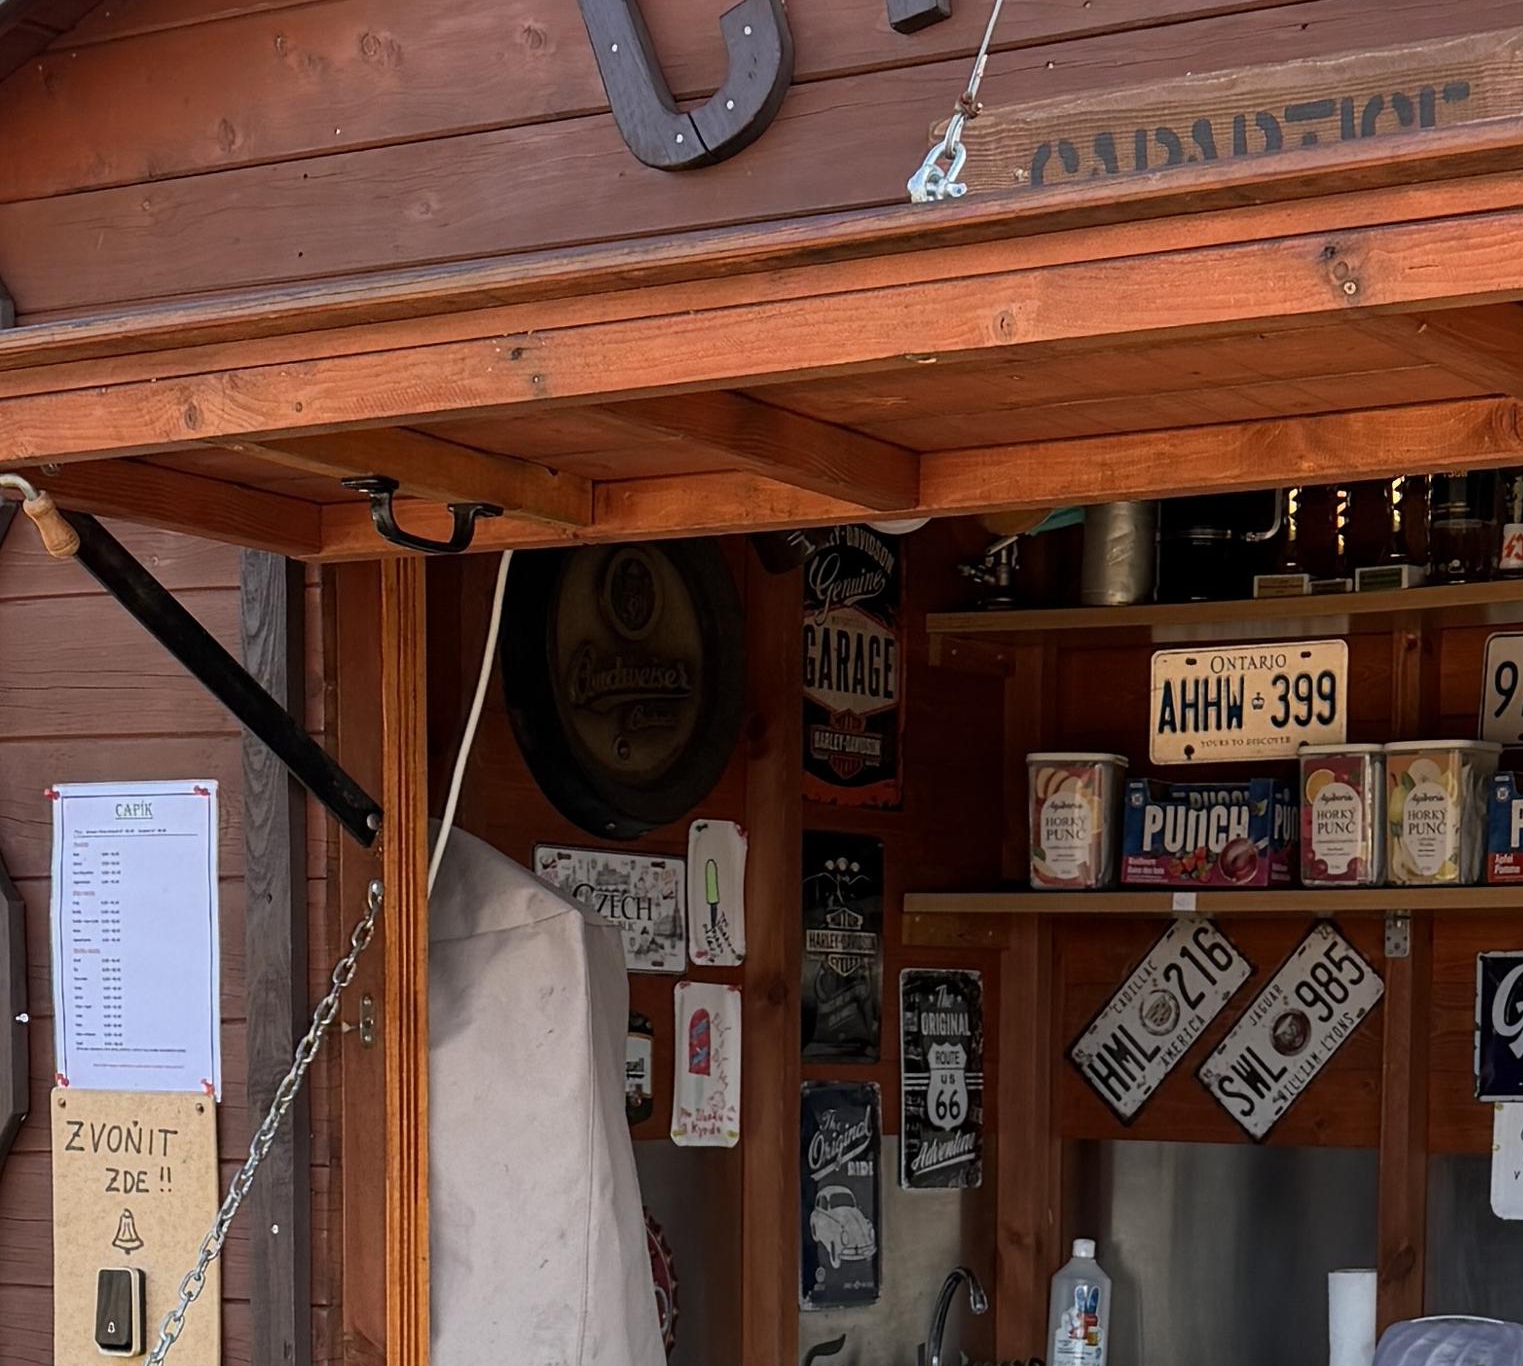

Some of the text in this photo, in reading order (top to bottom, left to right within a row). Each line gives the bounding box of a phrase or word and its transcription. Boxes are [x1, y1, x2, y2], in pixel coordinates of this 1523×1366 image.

[808, 552, 887, 625] Genuine
[803, 624, 894, 699] GARAGE
[1210, 653, 1287, 674] ONTARIO
[1158, 670, 1336, 734] AHHW 399
[1200, 738, 1230, 748] YOURS
[1233, 738, 1244, 747] TO
[115, 800, 153, 817] CAPÍK
[1142, 804, 1251, 853] PUNCH
[1112, 959, 1158, 1014] CADILLAC
[1250, 983, 1284, 1027] JAGUAR
[920, 1011, 972, 1037] ORIGINAL
[1087, 926, 1233, 1101] HML 216
[1218, 941, 1366, 1117] SWL 985
[935, 1051, 961, 1065] ROUTE
[1159, 1014, 1206, 1068] AMERICA
[940, 1074, 956, 1084] US
[819, 1108, 841, 1131] The
[936, 1090, 961, 1120] 66
[808, 1104, 873, 1170] Original
[105, 1168, 149, 1194] ZDE
